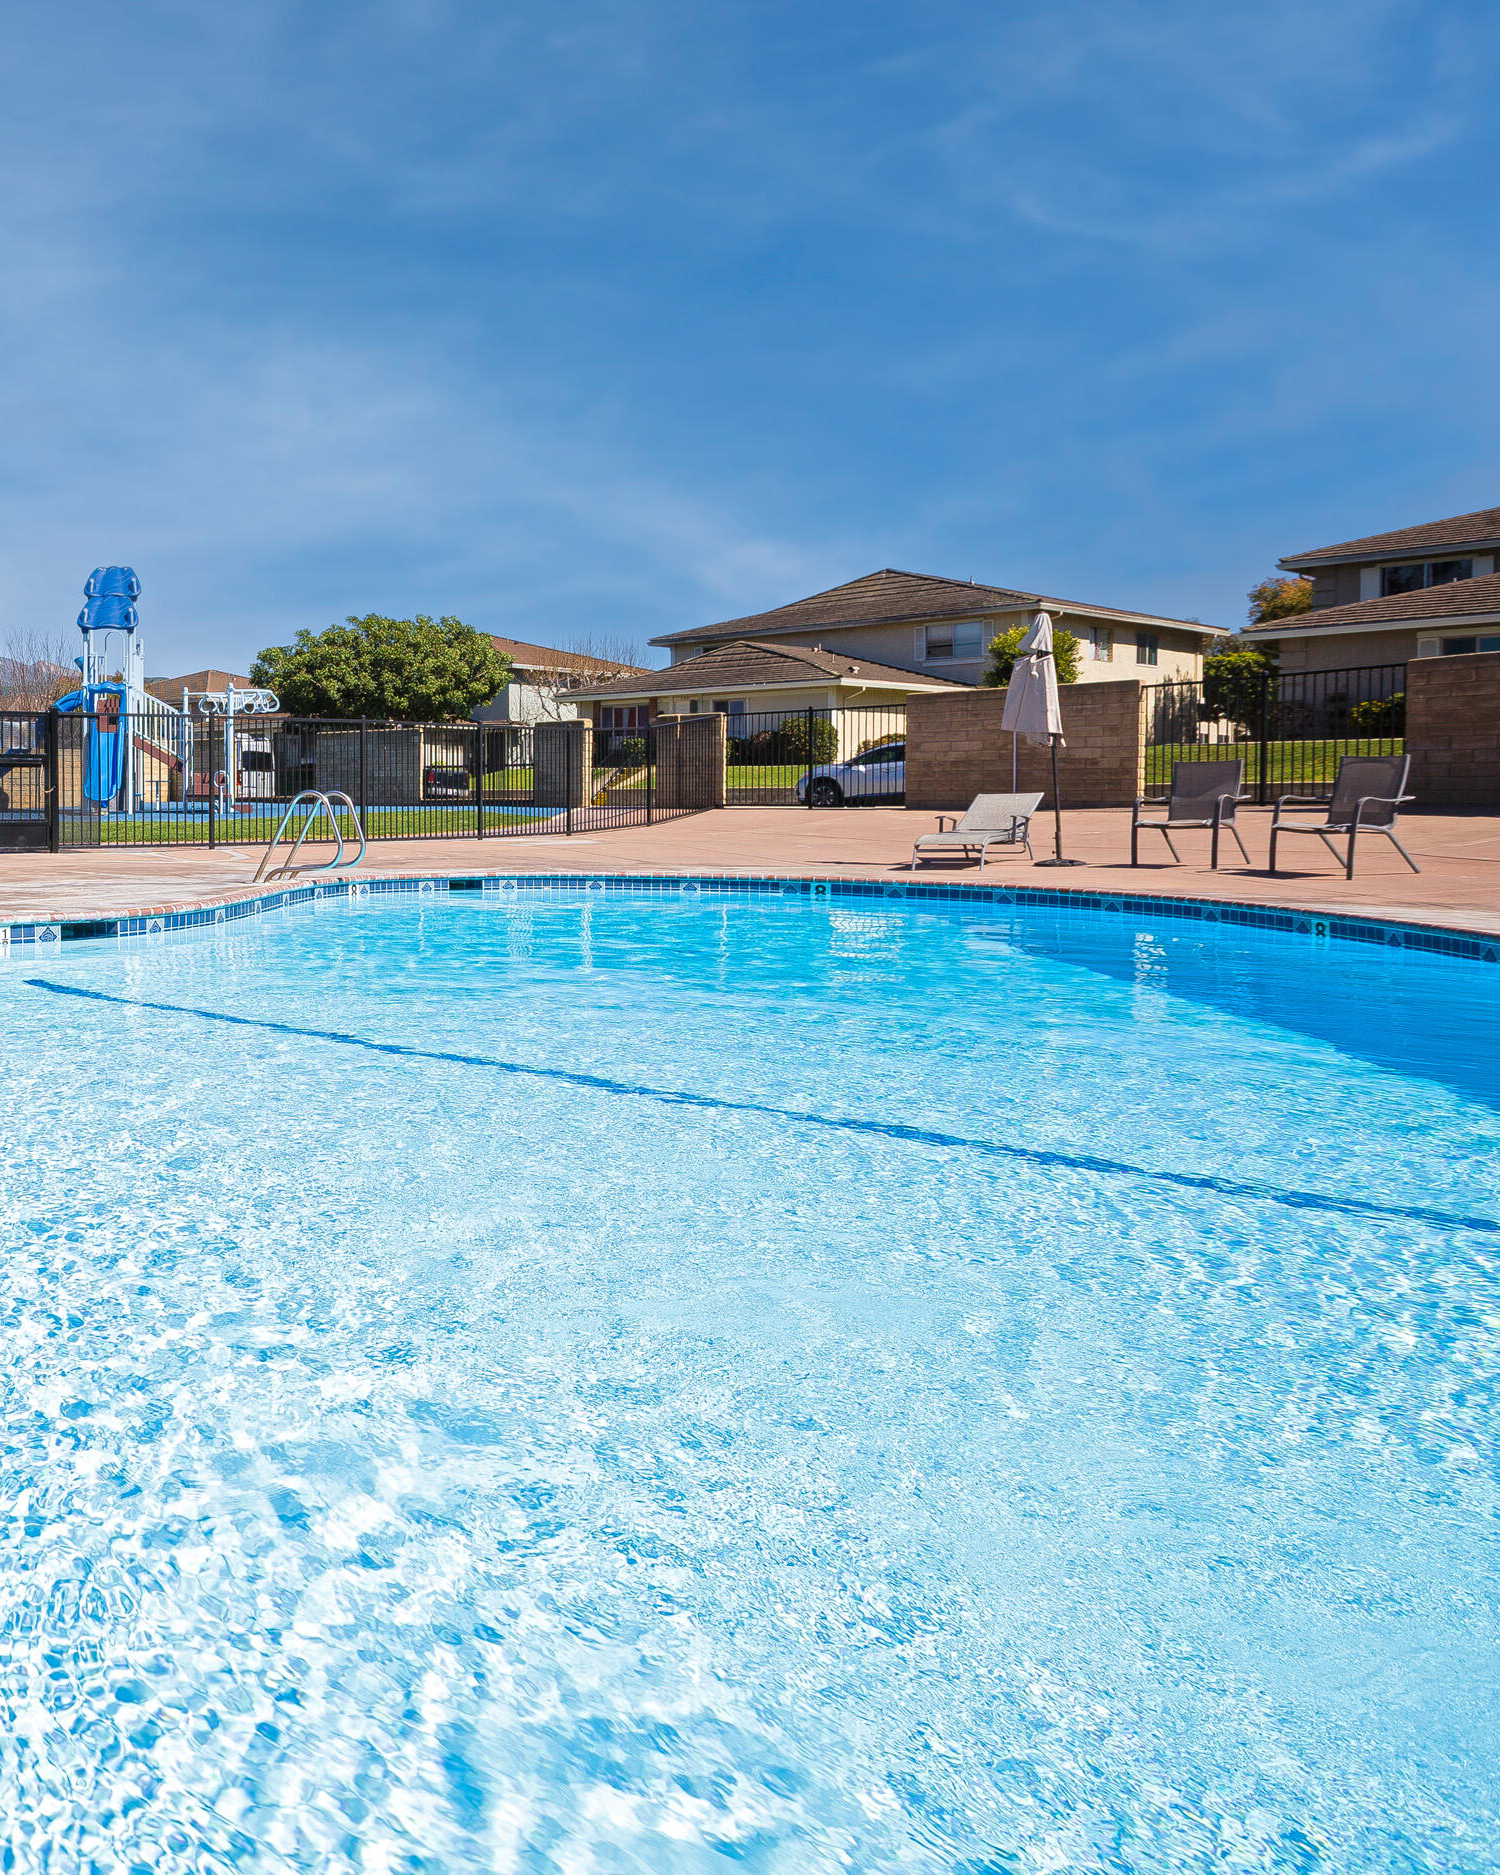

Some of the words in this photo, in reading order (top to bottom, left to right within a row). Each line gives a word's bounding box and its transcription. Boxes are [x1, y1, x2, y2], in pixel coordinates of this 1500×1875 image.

[351, 884, 358, 896] 8
[814, 884, 827, 895] 8
[1315, 922, 1325, 937] 8
